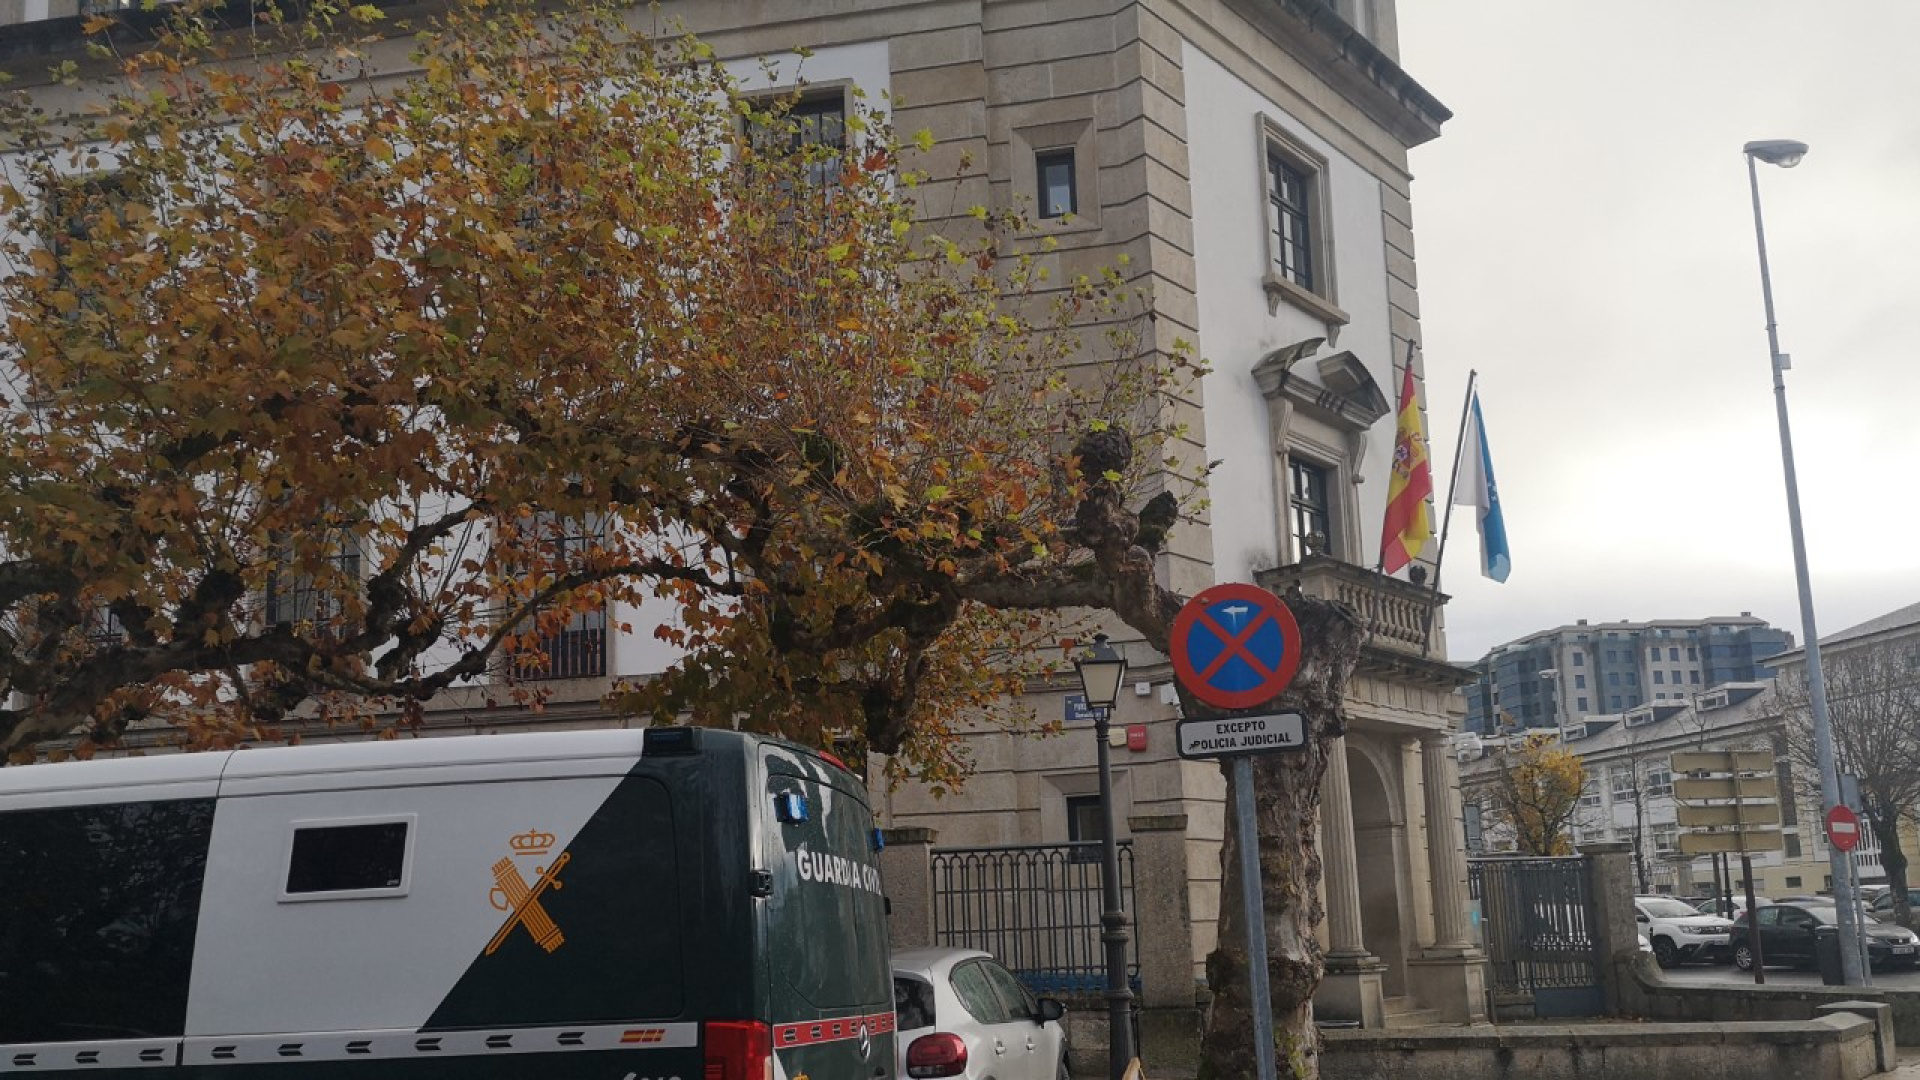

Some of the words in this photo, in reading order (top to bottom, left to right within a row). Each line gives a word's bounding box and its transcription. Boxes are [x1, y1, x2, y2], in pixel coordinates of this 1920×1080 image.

[1216, 720, 1266, 735] EXCEPTO
[1193, 737, 1237, 750] POLICIA
[1240, 732, 1292, 747] JUDICIAL
[797, 849, 862, 889] GUARDIA
